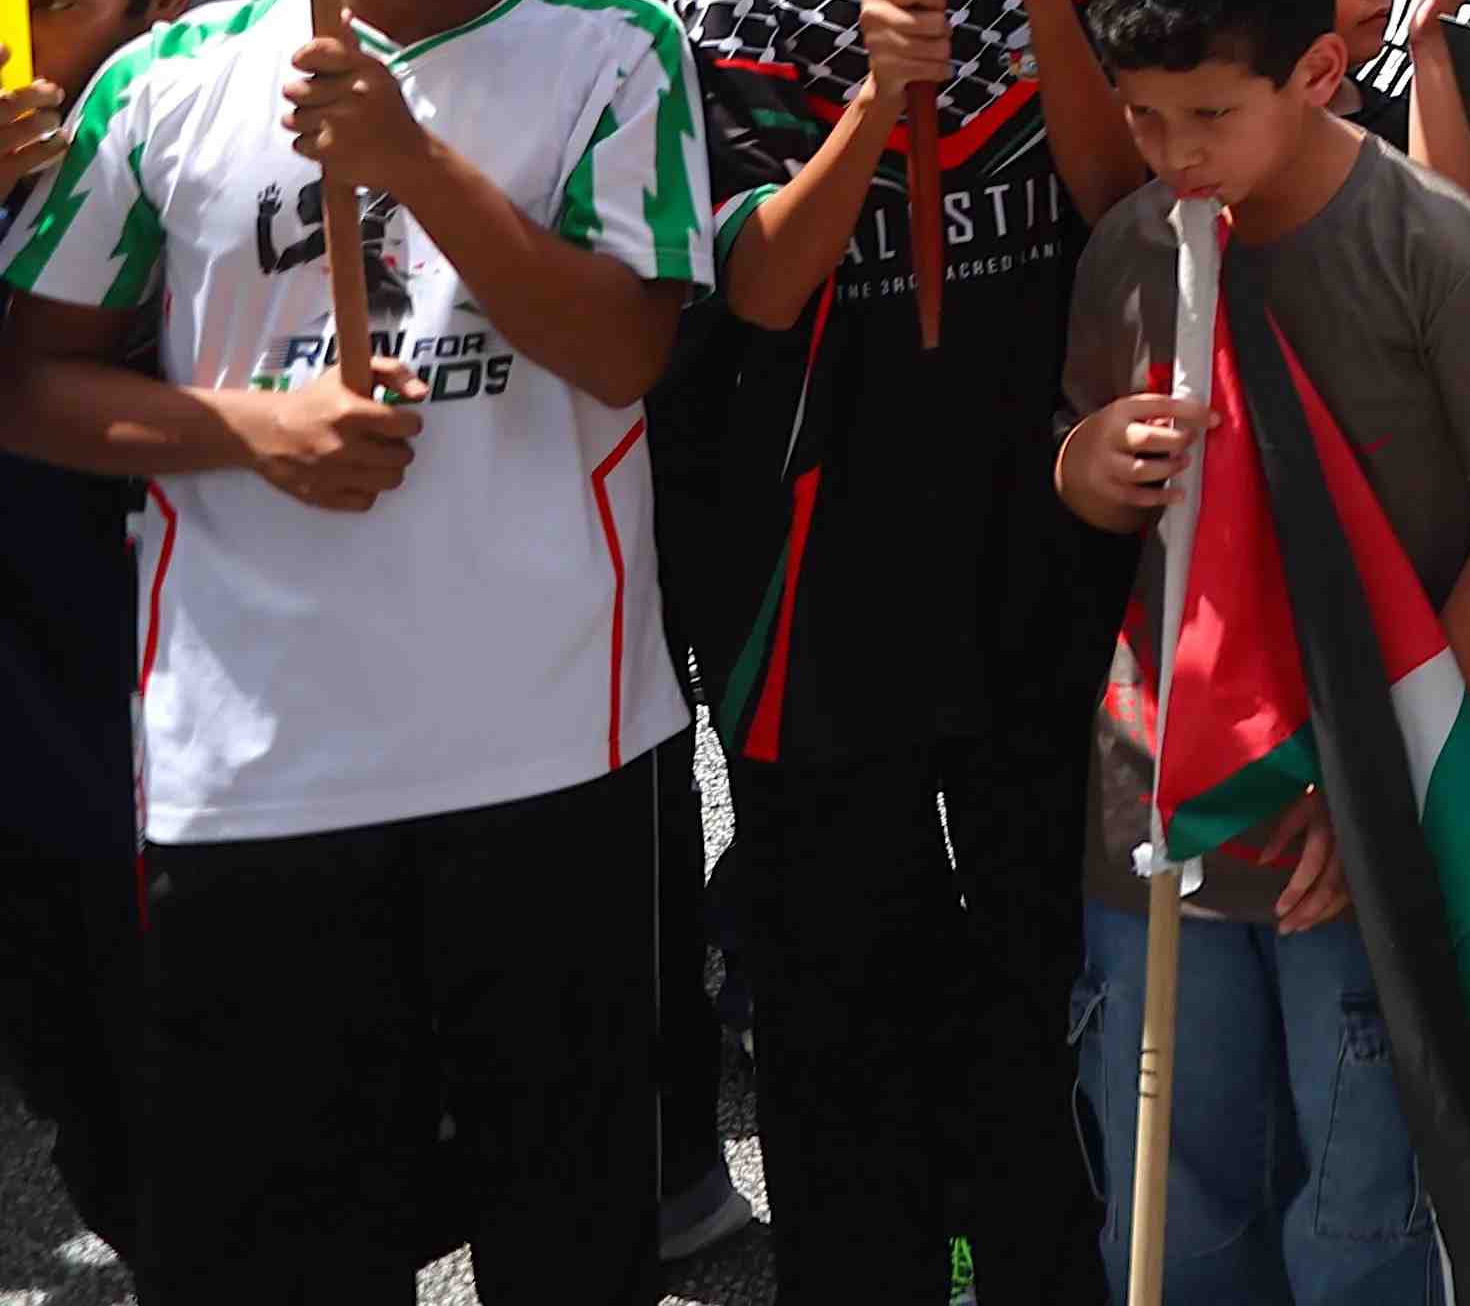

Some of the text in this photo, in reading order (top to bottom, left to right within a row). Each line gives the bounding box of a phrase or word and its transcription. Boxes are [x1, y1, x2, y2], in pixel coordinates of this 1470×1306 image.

[946, 254, 1013, 281] ACRED
[284, 331, 486, 368] RN FOR
